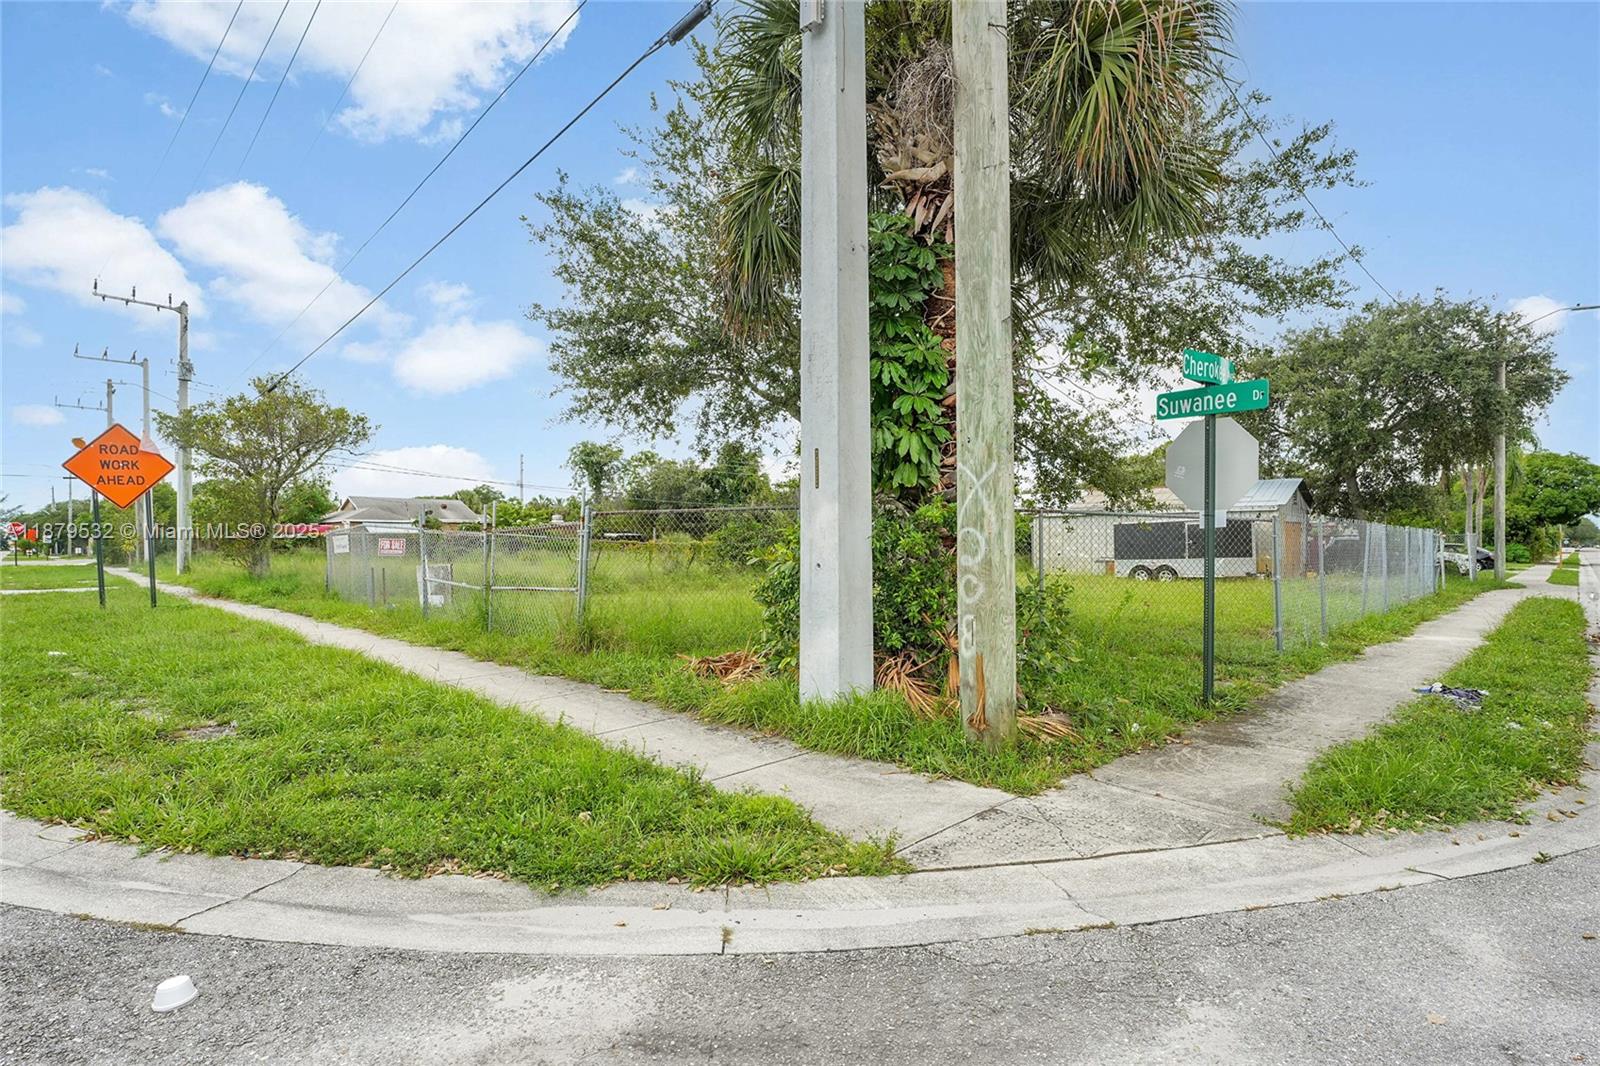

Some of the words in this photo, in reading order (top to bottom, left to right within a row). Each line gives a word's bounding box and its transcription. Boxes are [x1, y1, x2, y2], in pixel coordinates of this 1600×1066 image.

[1159, 392, 1237, 416] Suwanee
[1252, 389, 1264, 400] Dr
[99, 444, 138, 455] ROAD
[99, 460, 139, 470] WORK
[96, 475, 145, 485] AHEAD
